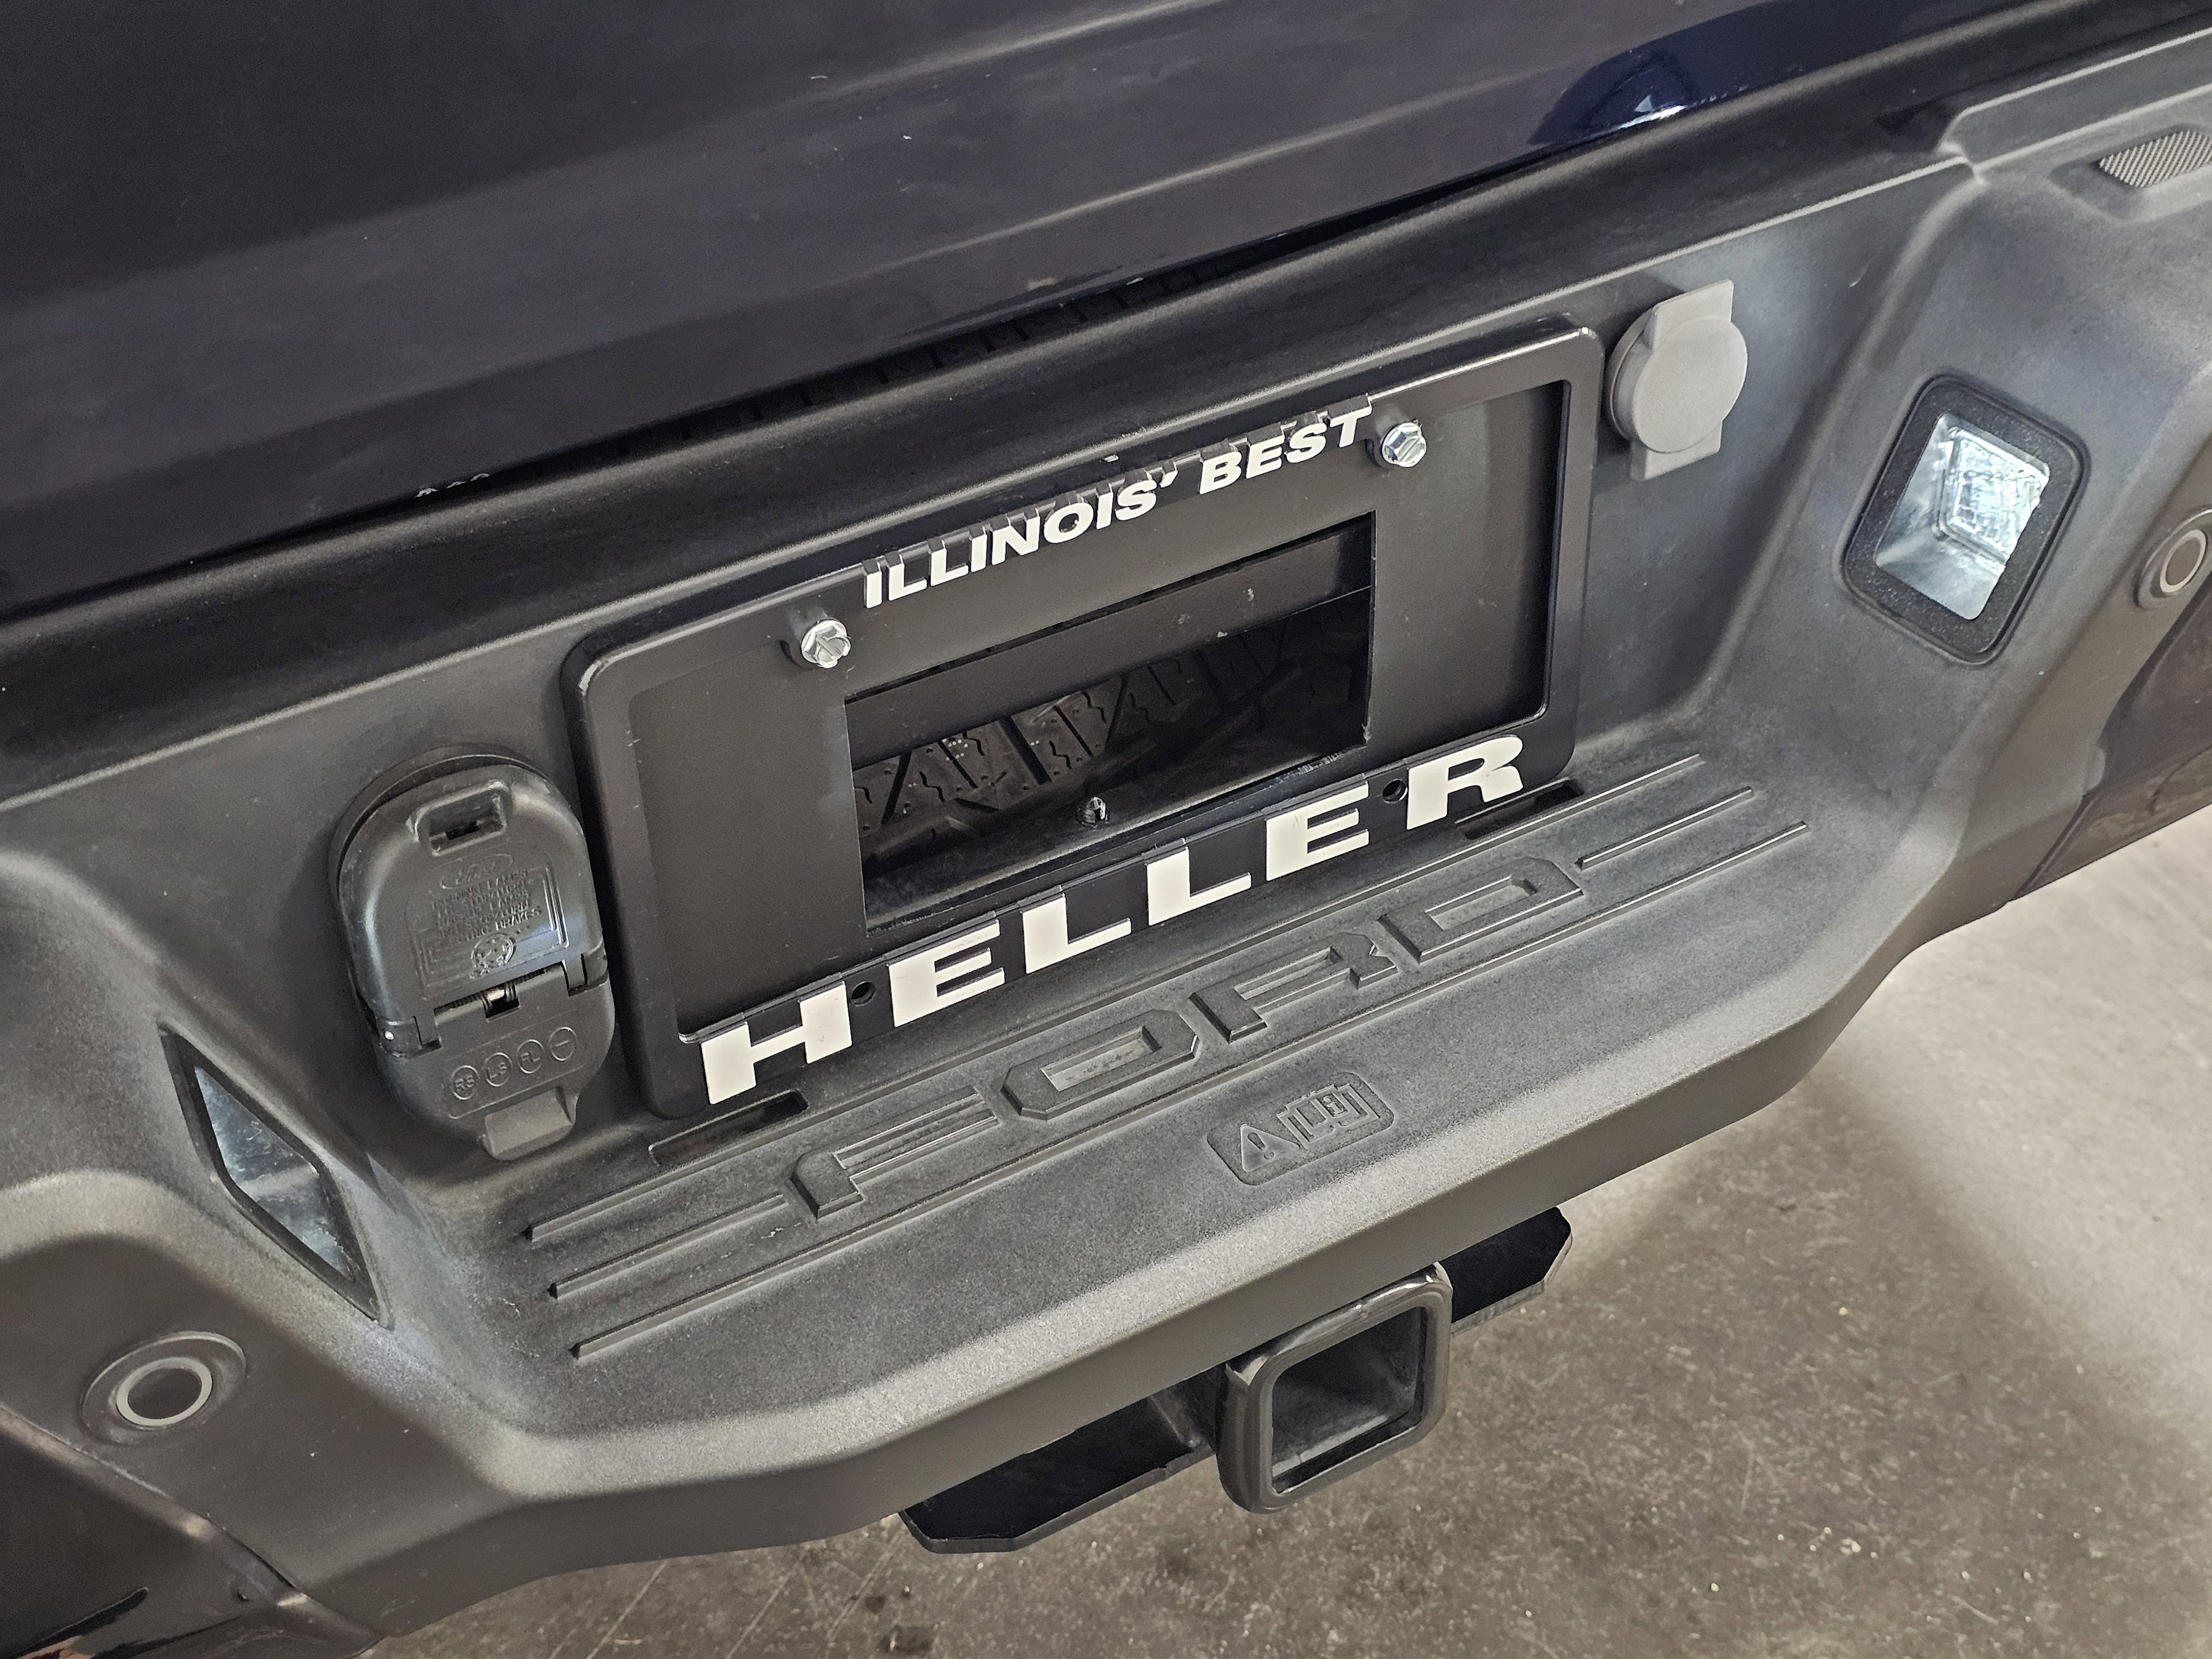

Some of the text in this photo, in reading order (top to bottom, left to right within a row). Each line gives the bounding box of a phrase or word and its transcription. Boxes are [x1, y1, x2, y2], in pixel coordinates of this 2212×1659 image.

[864, 406, 1373, 609] ILLINOIS' BEST
[486, 868, 529, 890] LAMPS
[494, 906, 540, 932] BRAKES
[700, 736, 1525, 1105] HELLER
[790, 855, 1585, 1217] FORD
